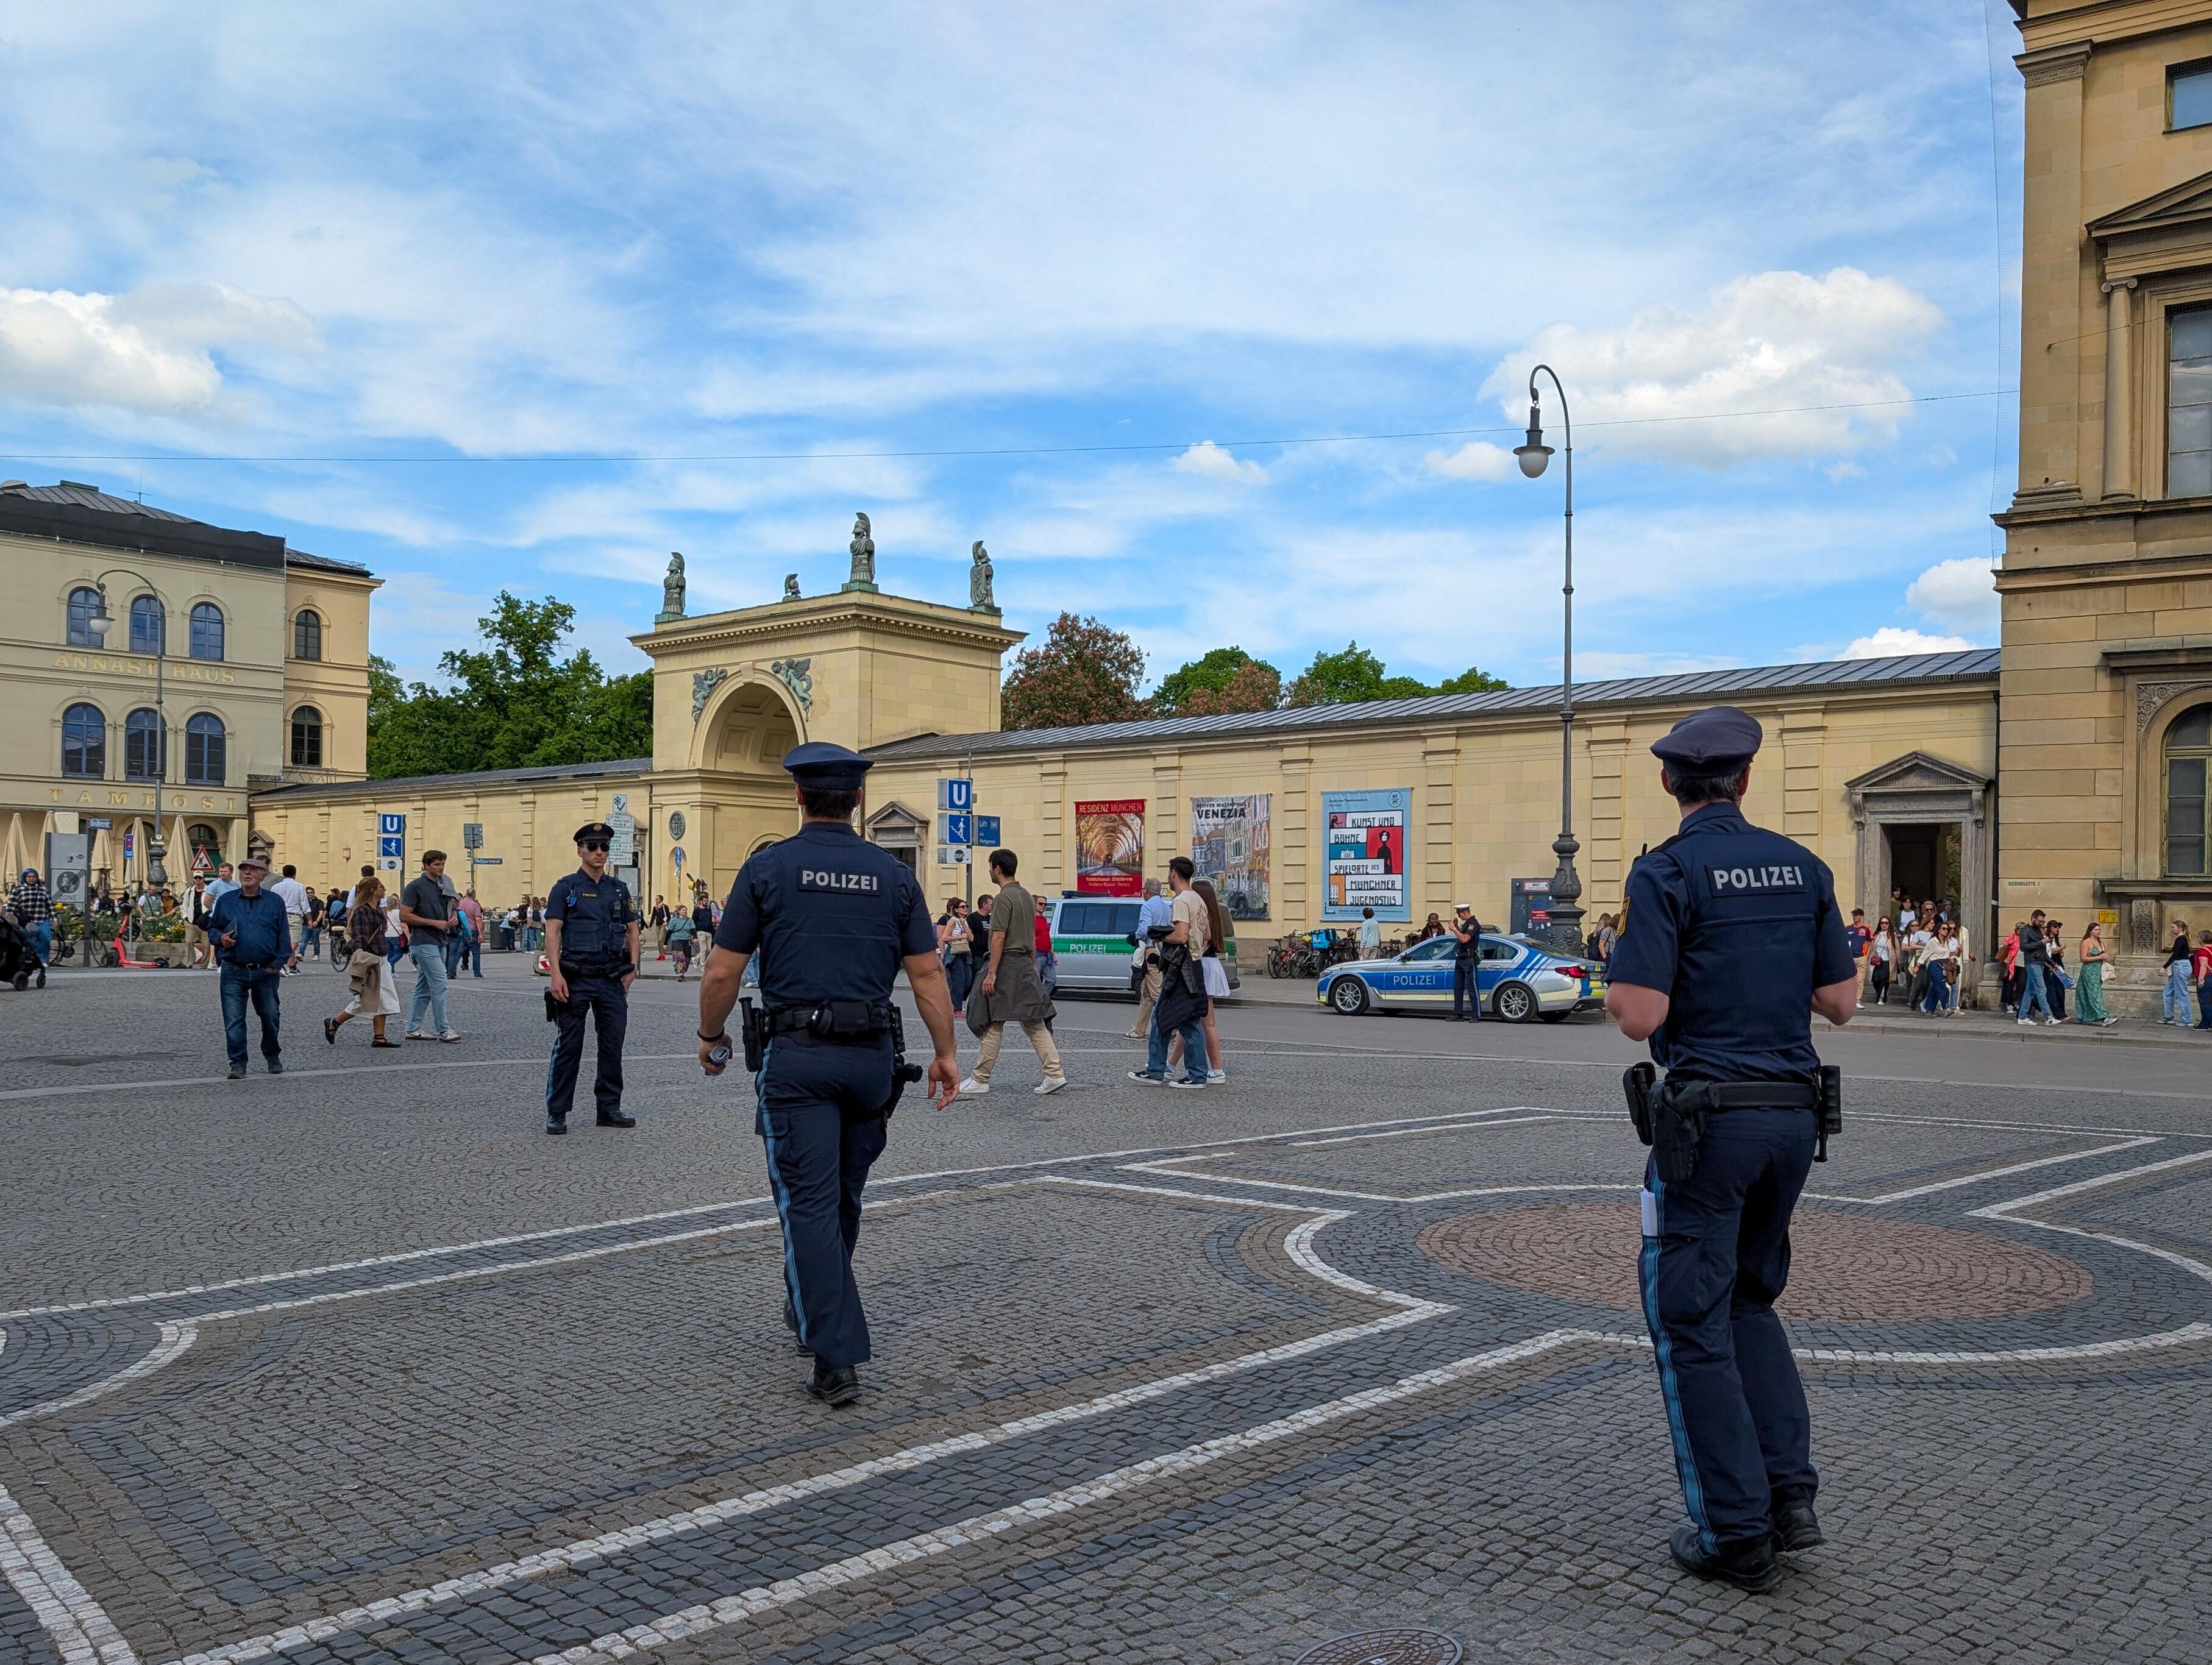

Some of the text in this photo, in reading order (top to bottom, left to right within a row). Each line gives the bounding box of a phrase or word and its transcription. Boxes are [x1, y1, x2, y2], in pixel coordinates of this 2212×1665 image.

[52, 653, 236, 683] ANNAST HAUS
[48, 789, 236, 810] TAMBOSI
[953, 784, 967, 805] U
[1079, 801, 1142, 813] RESIDENZ MÜNCHEN
[1196, 808, 1246, 820] VENEZIA
[386, 817, 398, 831] U
[1351, 817, 1395, 828] KUNST UND
[1334, 834, 1360, 843] BÜHNE
[1334, 865, 1369, 874] SPIELORTE
[802, 870, 877, 890] POLIZEI
[1713, 866, 1804, 890] POLIZEI
[1350, 880, 1396, 890] MÜNCHNER
[1350, 896, 1396, 905] JUGENDSTILS
[1070, 943, 1106, 953] POLIZEI
[1393, 975, 1435, 985] POLIZEI
